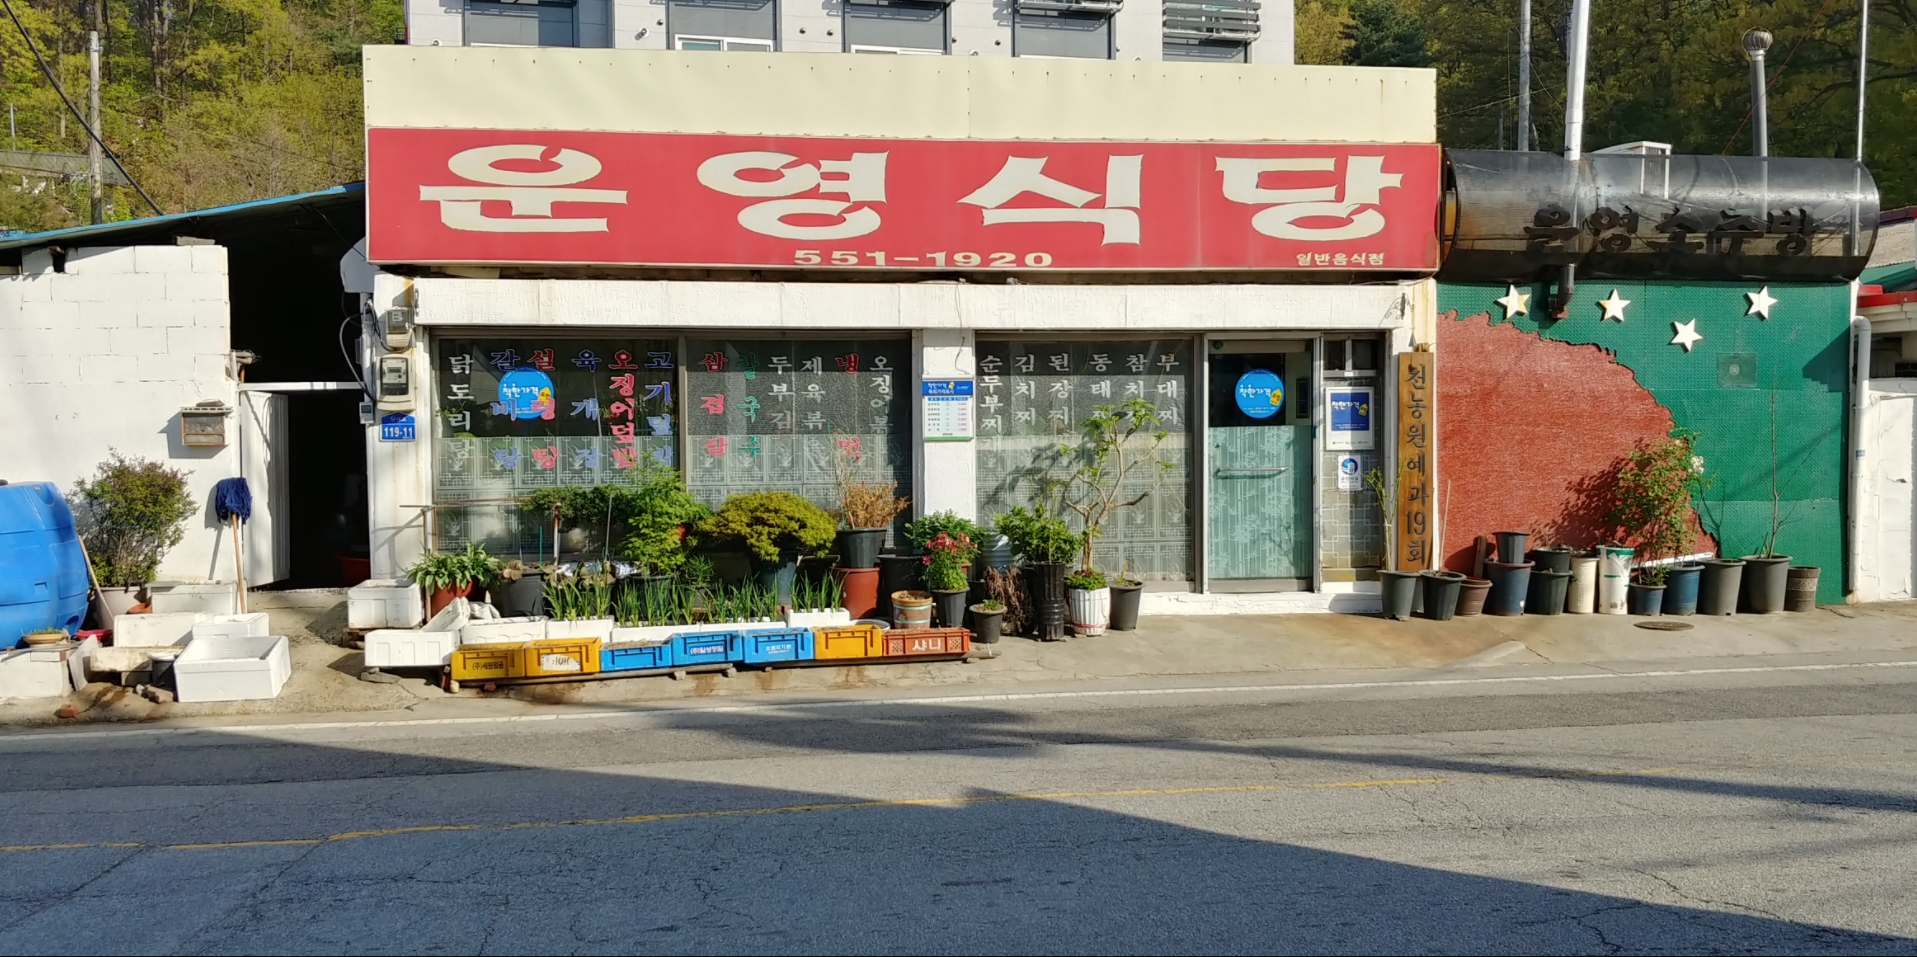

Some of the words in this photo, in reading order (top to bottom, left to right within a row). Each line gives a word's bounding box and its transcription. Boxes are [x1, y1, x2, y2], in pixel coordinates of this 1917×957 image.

[419, 144, 1404, 246] 운영식당
[794, 249, 1053, 267] 551-1920
[1296, 251, 1385, 266] 일반음식점
[446, 354, 475, 459] 닭도리탕
[490, 349, 522, 469] 갈비탕
[503, 383, 539, 398] 착한가격
[570, 350, 602, 468] 육개장
[608, 350, 639, 469] 오징어덮밥
[698, 352, 729, 456] 삼겹살
[735, 352, 760, 459] 칼국수
[1239, 384, 1271, 398] 착한가격
[1332, 400, 1360, 411] 착한가격
[384, 426, 413, 438] 119-11
[912, 638, 941, 651] 샤니
